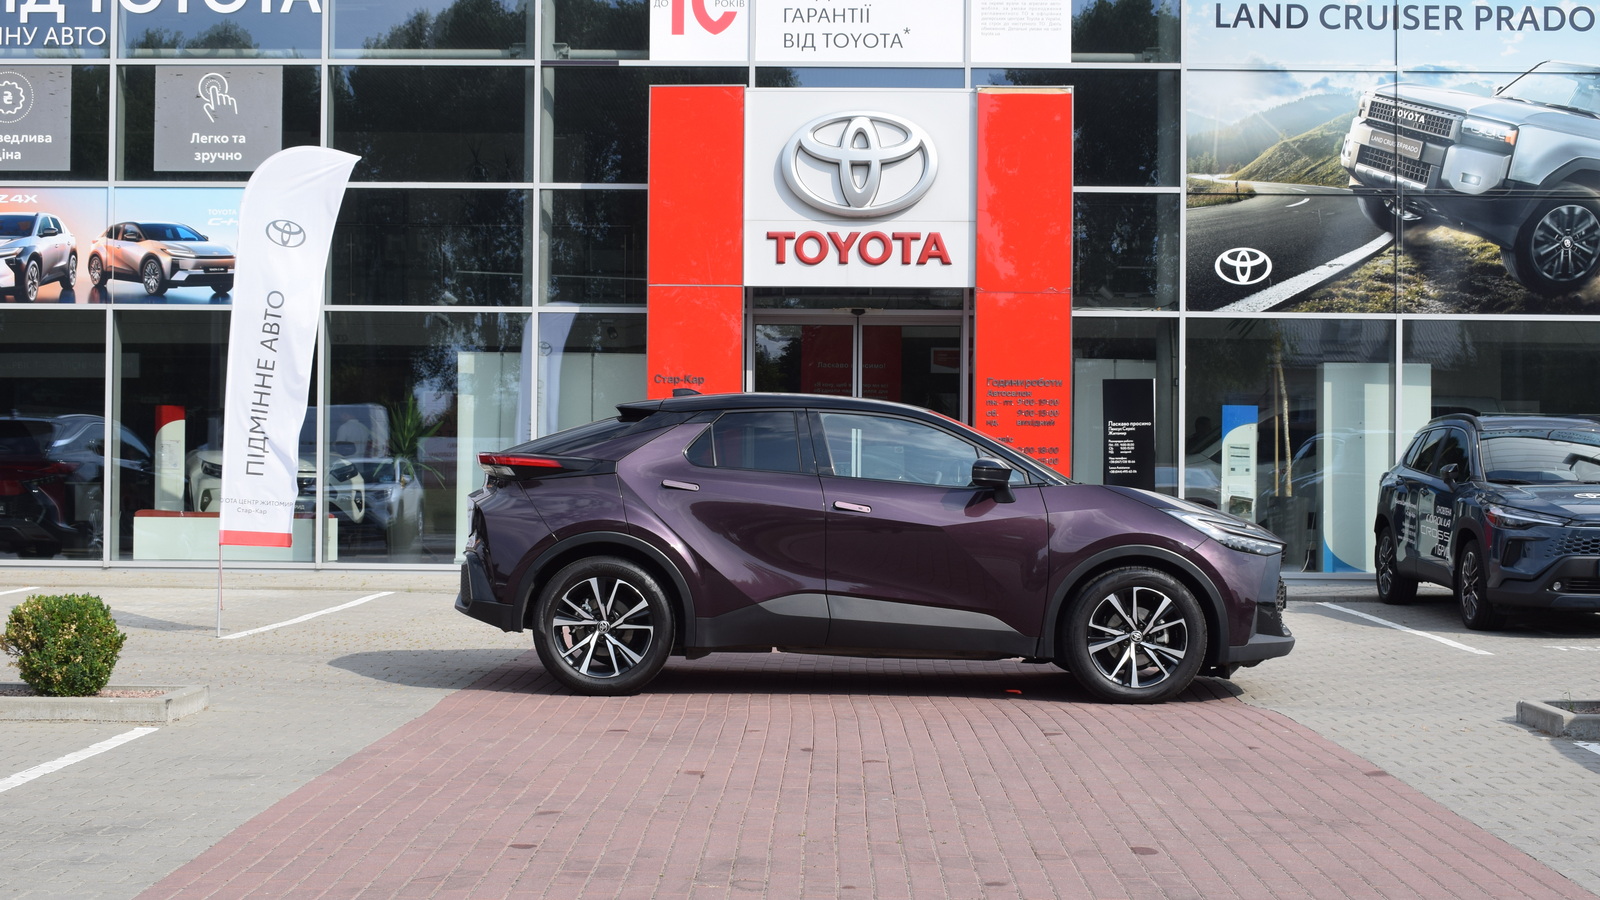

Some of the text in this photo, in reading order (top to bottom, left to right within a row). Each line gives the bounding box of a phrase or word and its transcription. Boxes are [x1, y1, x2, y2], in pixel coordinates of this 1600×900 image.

[783, 4, 872, 23] ГАРАНТІЇ
[1215, 3, 1596, 32] LAND CRUISER PRADO
[0, 26, 107, 46] НУ АВТО
[783, 33, 817, 52] ВІД
[1391, 108, 1426, 124] TOYOTA
[190, 132, 247, 144] Легко та
[1371, 135, 1384, 144] LAND
[1402, 142, 1419, 153] PRADO
[194, 151, 243, 164] зручно
[208, 208, 238, 216] TOYOTA
[766, 230, 953, 266] TOYOTA
[245, 288, 286, 477] ПІДМІННЕ АВТО
[653, 374, 705, 385] Стар-Кар
[1025, 377, 1063, 389] роботи
[987, 389, 1032, 397] Автосалон
[236, 506, 268, 515] Стар-Кар
[1425, 513, 1452, 528] COROLLA
[1420, 524, 1451, 542] CROSS
